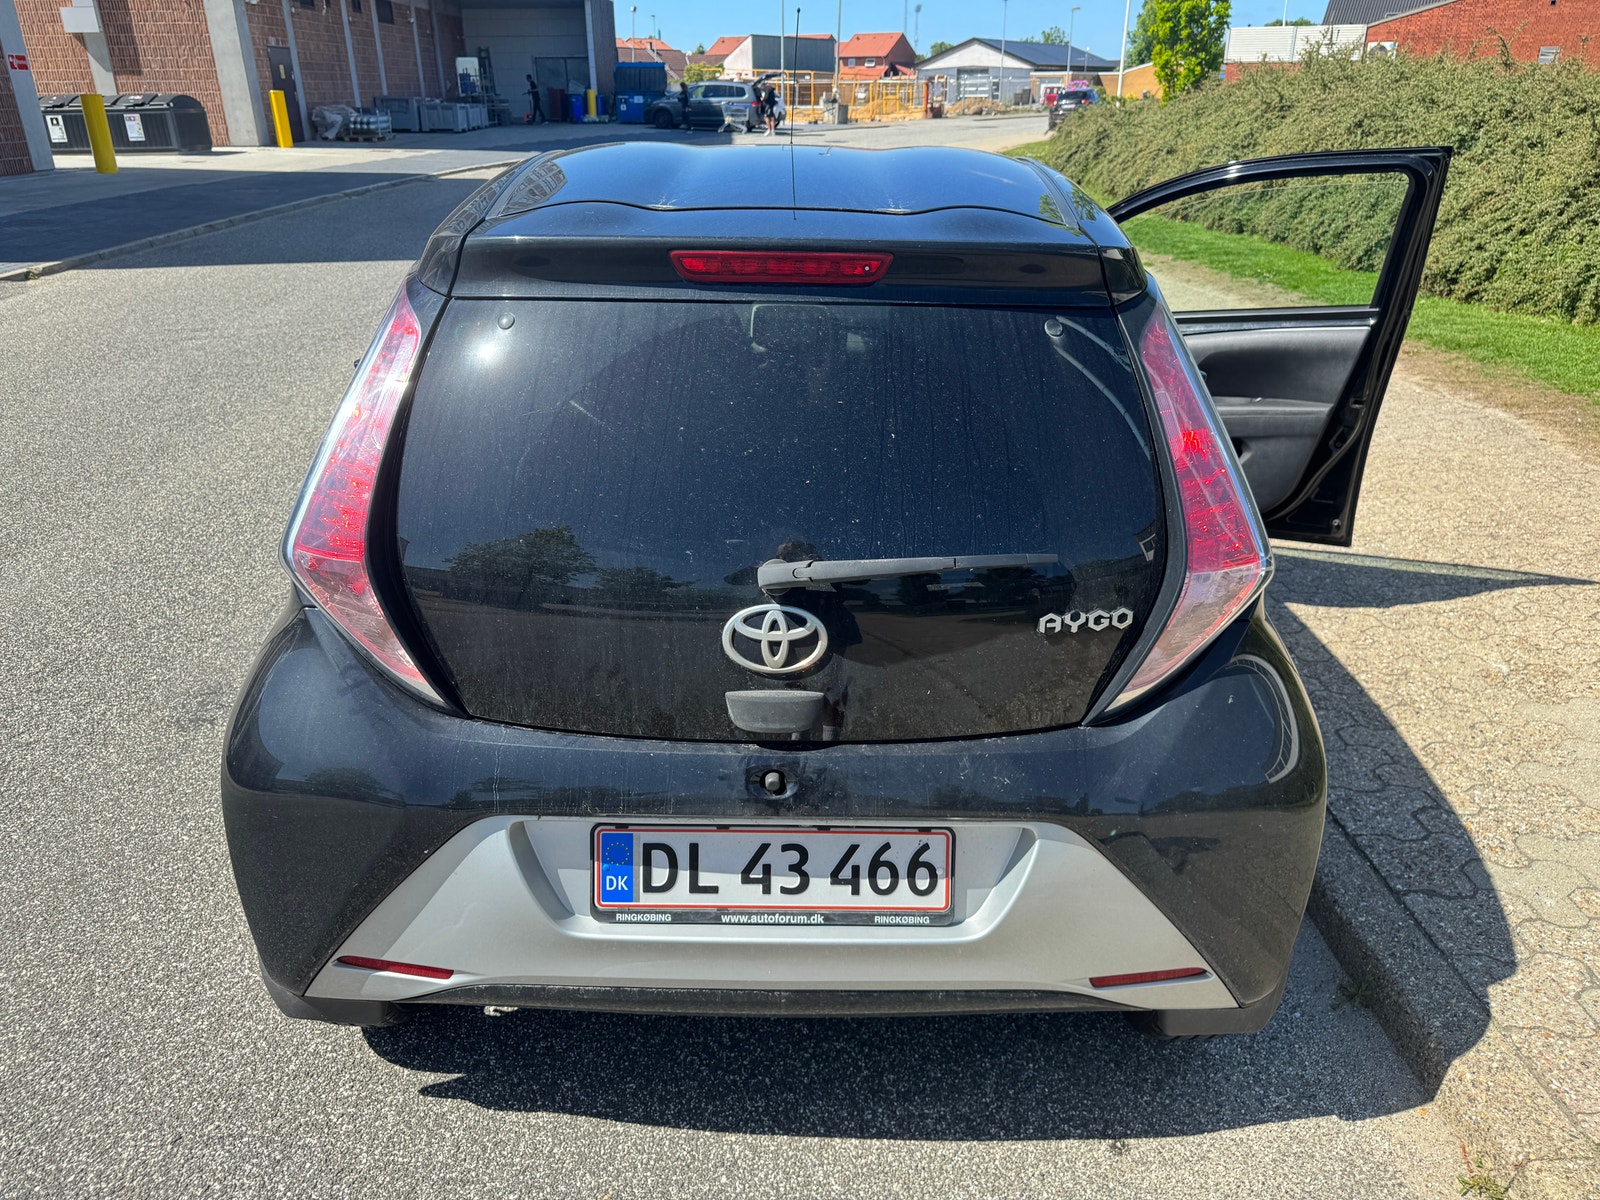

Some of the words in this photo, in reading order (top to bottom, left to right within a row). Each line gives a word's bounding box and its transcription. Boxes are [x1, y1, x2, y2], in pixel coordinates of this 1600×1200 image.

[1038, 607, 1134, 634] AYGO
[642, 842, 719, 894] DL
[740, 842, 810, 895] 43
[829, 841, 938, 897] 466
[605, 875, 629, 891] DK
[615, 913, 672, 922] RINGKØBING
[720, 913, 825, 924] www.autoforum.dk
[874, 915, 930, 924] RINGKØBING
